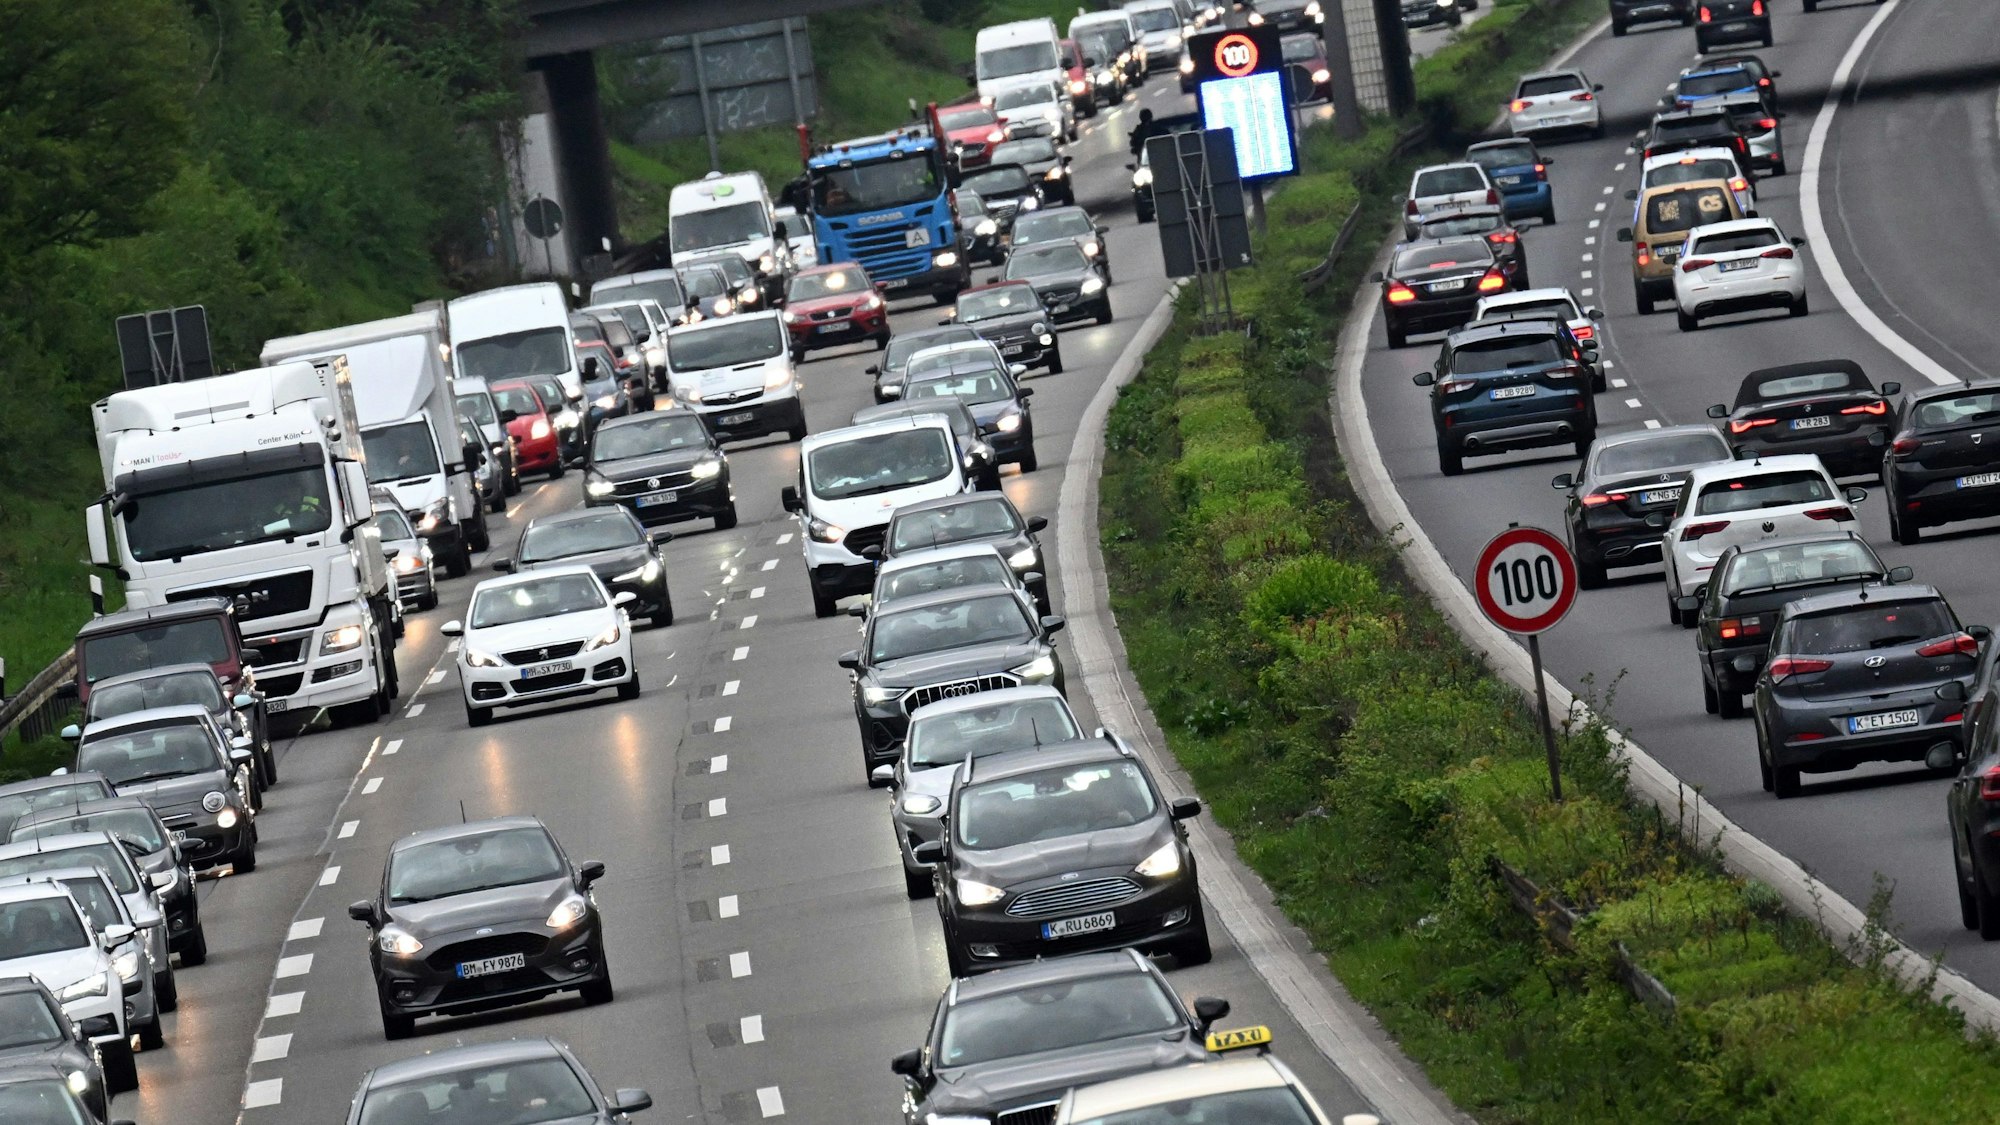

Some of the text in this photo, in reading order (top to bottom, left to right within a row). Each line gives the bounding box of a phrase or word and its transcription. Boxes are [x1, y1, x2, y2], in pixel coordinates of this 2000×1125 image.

[1223, 45, 1250, 66] 100
[913, 231, 925, 243] A
[1813, 416, 1828, 426] 283
[257, 432, 301, 445] Center Köln
[133, 457, 150, 466] MAN
[1961, 476, 1976, 486] LEV
[1646, 493, 1652, 501] K
[1658, 491, 1669, 500] NG
[1494, 554, 1557, 606] 100
[541, 666, 550, 675] SX
[552, 662, 570, 672] 7730
[1856, 710, 1917, 729] K ET 1502
[1050, 914, 1113, 935] K RU 6869
[462, 954, 524, 976] BM FY 9876
[1215, 1028, 1262, 1047] TAXI
